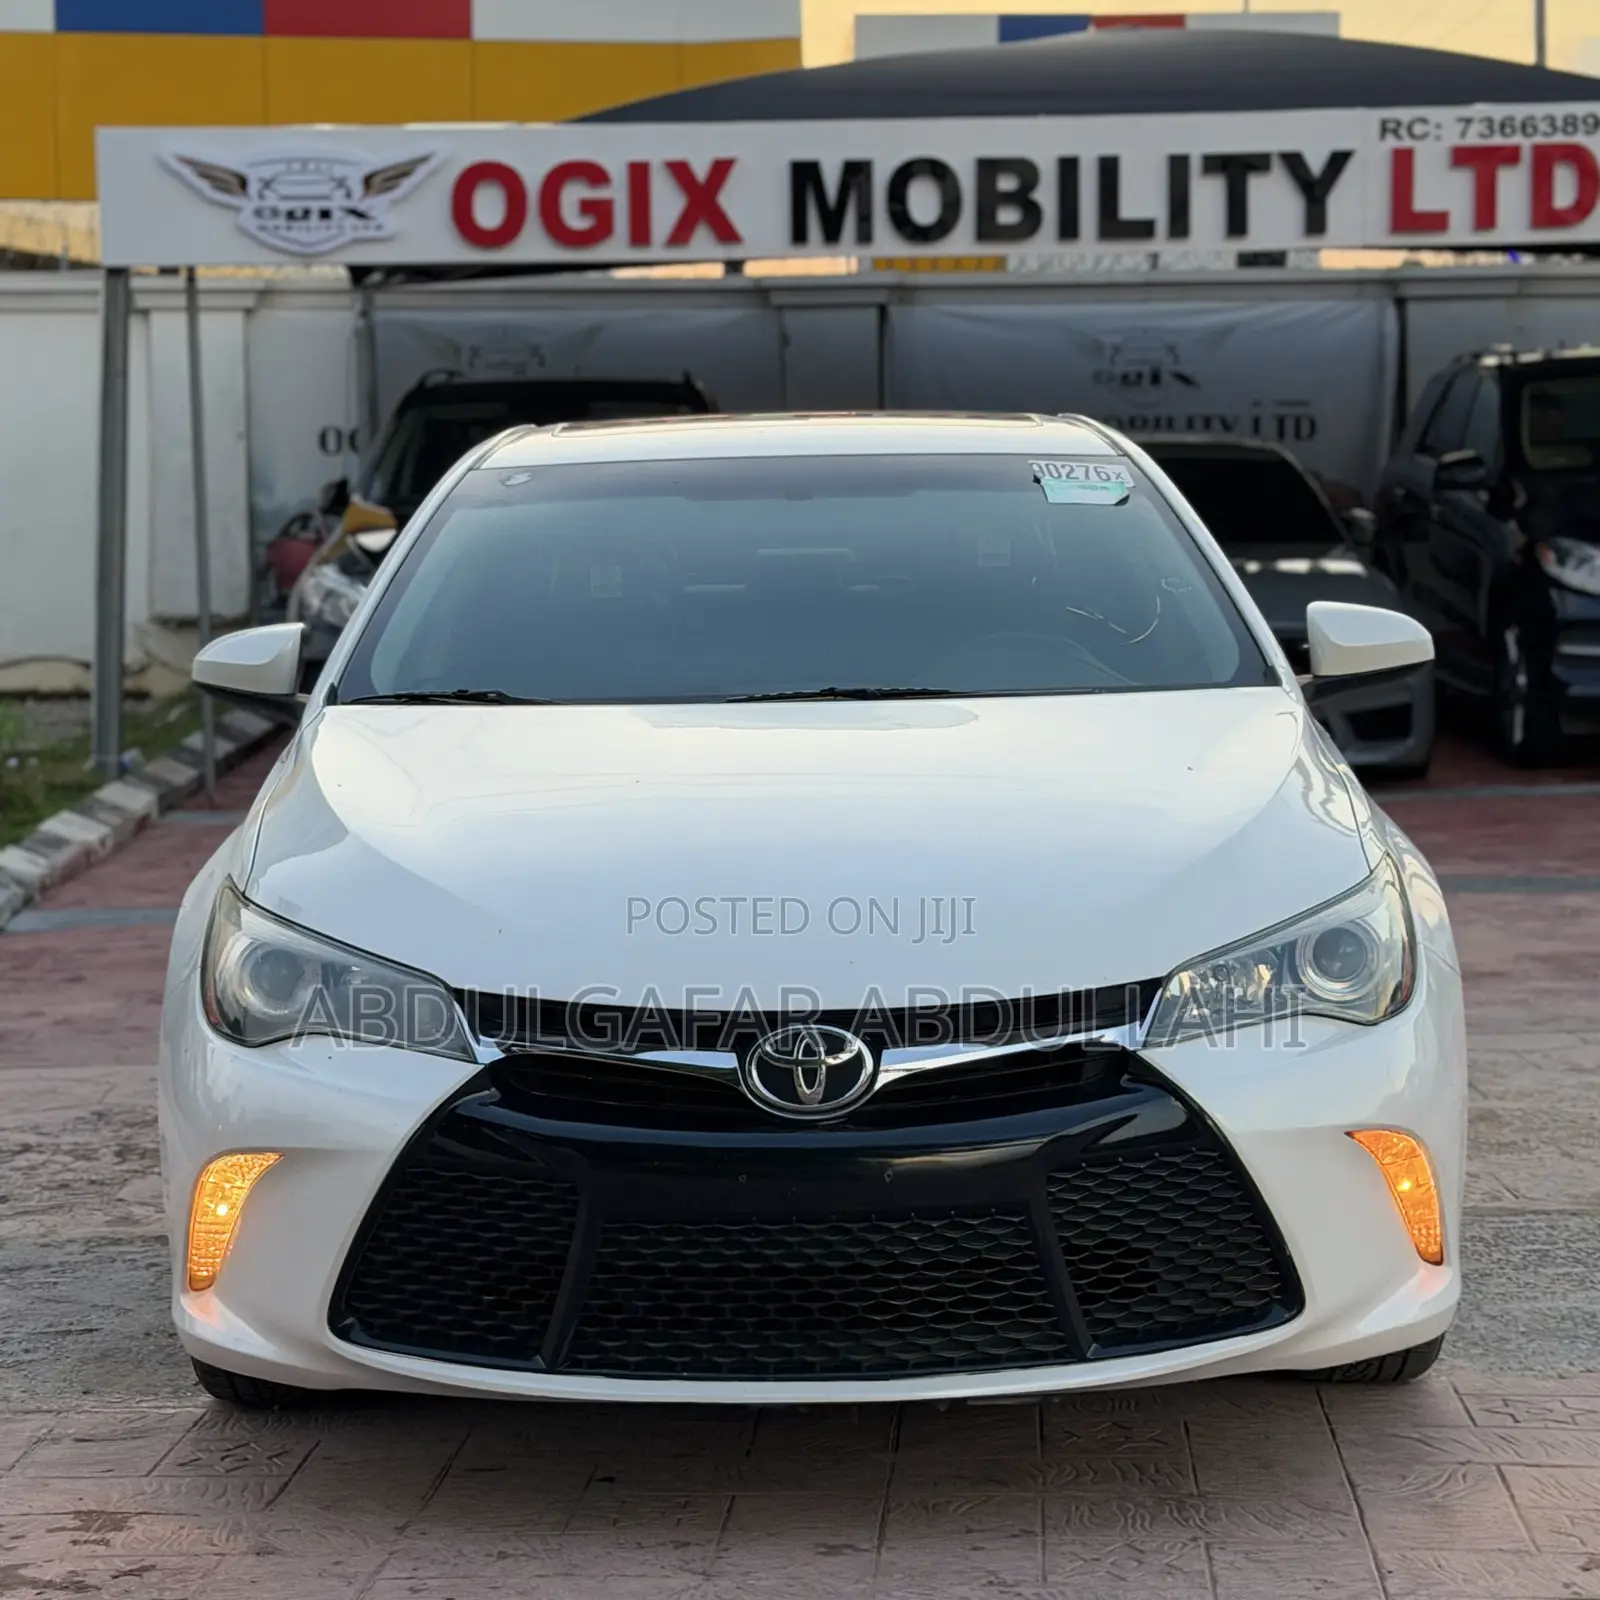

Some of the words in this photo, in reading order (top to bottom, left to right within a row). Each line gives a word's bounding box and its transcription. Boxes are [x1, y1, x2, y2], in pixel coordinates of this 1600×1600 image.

[1379, 117, 1443, 141] RC:
[1455, 113, 1600, 140] 7366389
[451, 157, 742, 249] OGIX
[792, 150, 1354, 246] MOBILITY
[1390, 141, 1600, 235] LTD
